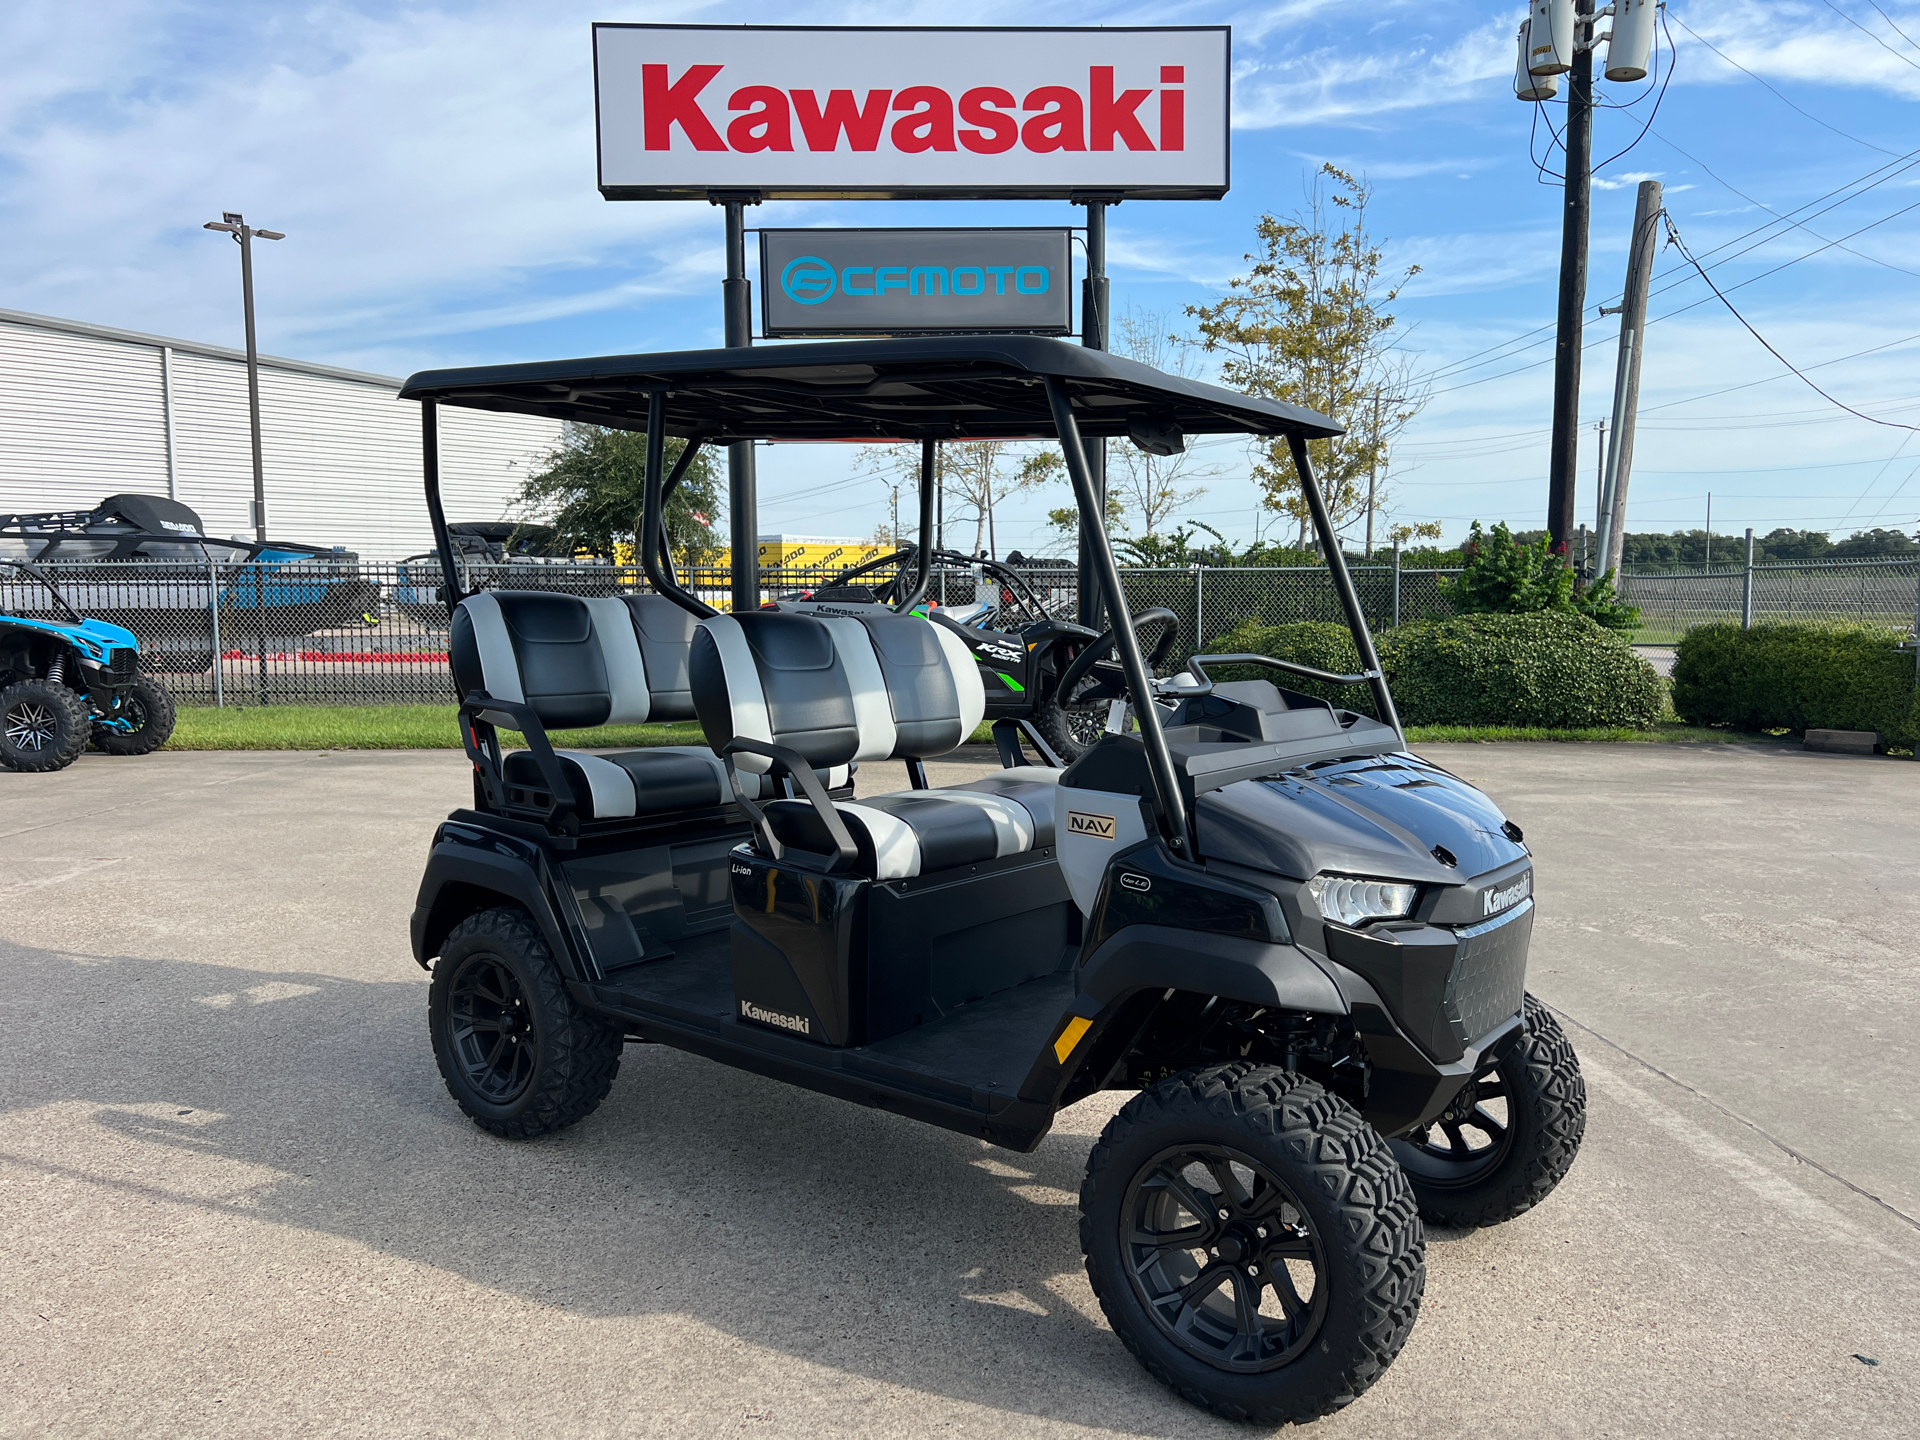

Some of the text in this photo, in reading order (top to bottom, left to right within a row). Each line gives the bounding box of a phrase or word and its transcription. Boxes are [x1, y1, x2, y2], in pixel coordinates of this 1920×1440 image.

[642, 64, 1185, 154] Kawasaki
[842, 266, 1050, 296] CFMOTO
[816, 604, 872, 616] Kawas
[976, 642, 1023, 659] KRX
[1071, 816, 1112, 834] NAV
[731, 864, 752, 875] Li-ion
[1483, 870, 1530, 916] Kawasaki
[741, 1000, 809, 1034] Kawasaki
